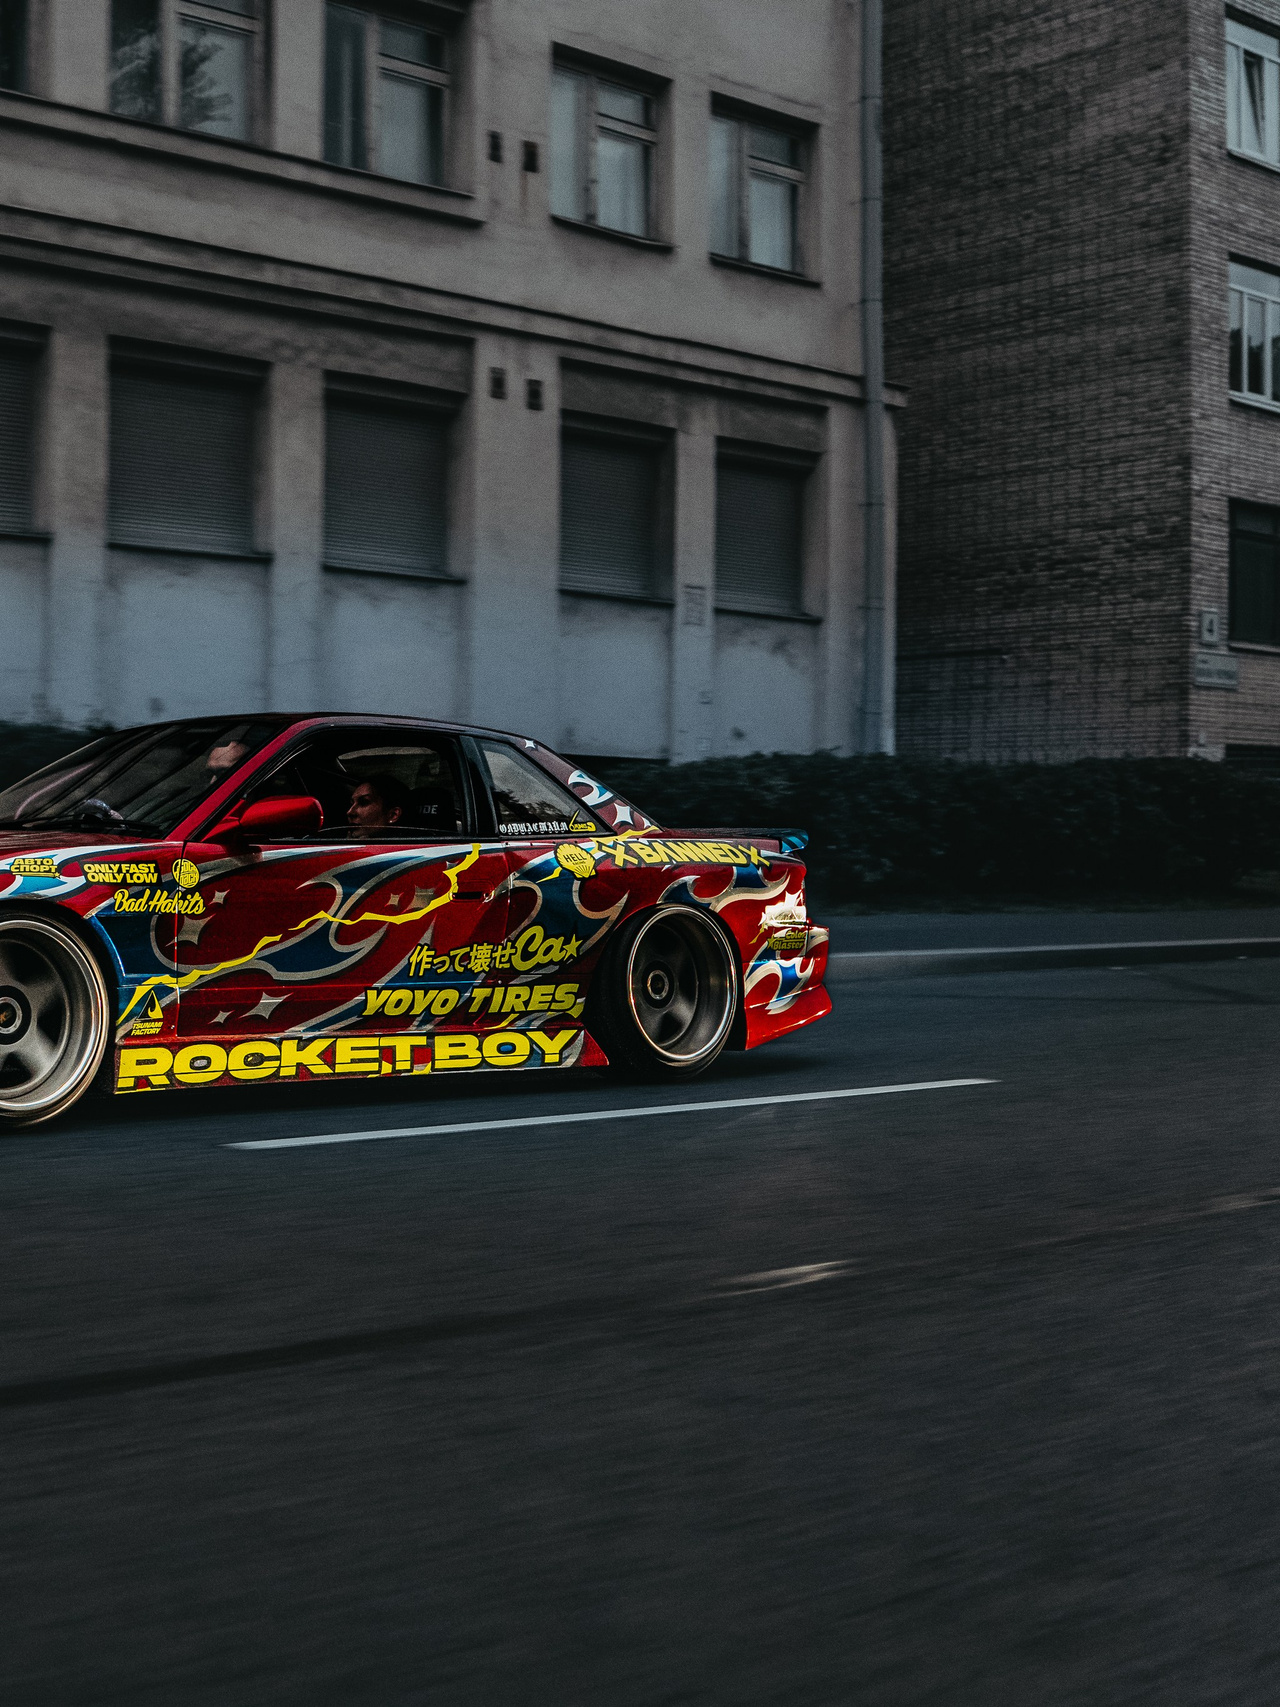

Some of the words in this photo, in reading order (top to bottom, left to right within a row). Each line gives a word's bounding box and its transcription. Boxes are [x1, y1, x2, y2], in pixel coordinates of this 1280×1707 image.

[563, 853, 587, 863] HELL
[628, 842, 748, 864] BANNED
[13, 858, 54, 866] АВТО
[10, 865, 58, 873] СПОРТ
[83, 863, 122, 873] ONLY
[121, 863, 156, 873] FAST
[87, 873, 125, 883] ONLY
[125, 873, 159, 884] LOW
[113, 888, 150, 913] Bad
[148, 889, 206, 915] Habits
[511, 925, 567, 972] Ca
[773, 940, 804, 950] Blaster
[408, 942, 516, 977] 作って壊せ
[361, 988, 460, 1016] YOYO
[468, 983, 580, 1014] TIRES
[132, 1021, 164, 1030] TSUNAMI
[130, 1028, 162, 1036] FACTORY
